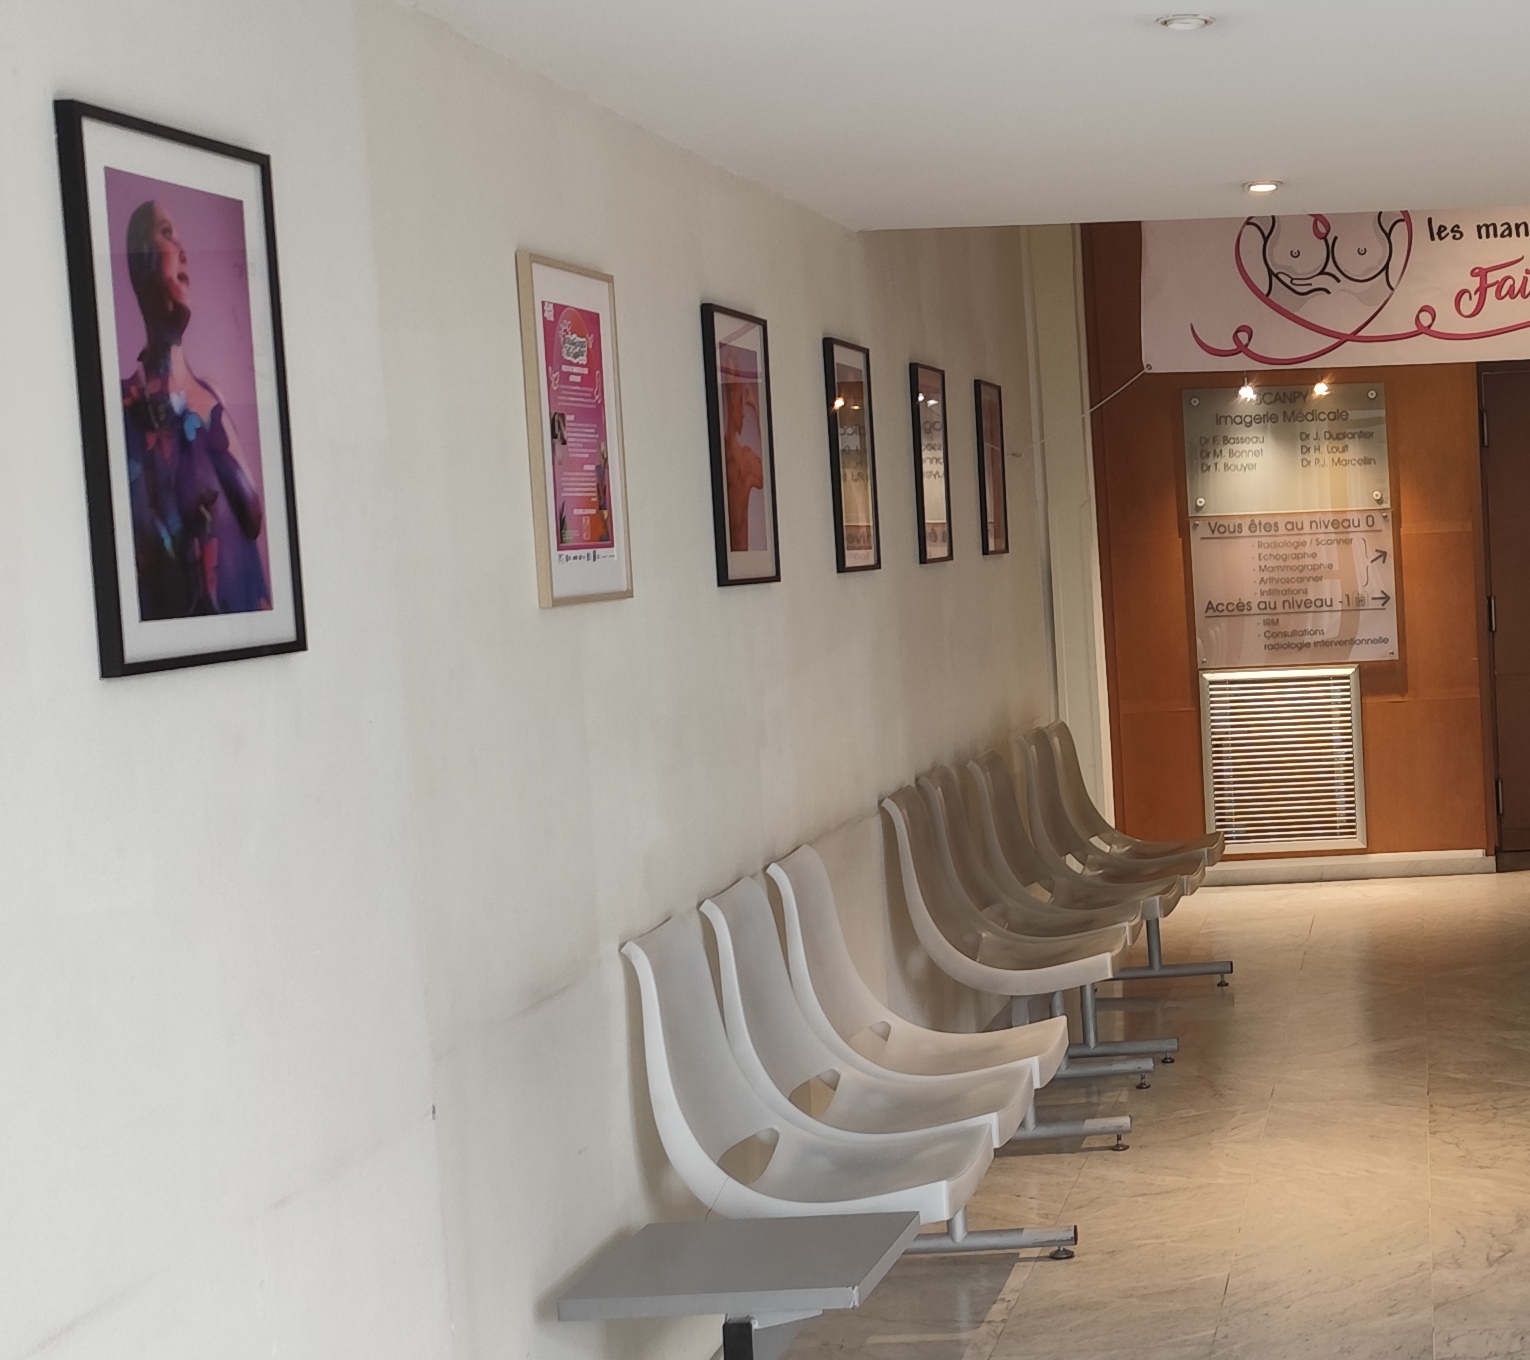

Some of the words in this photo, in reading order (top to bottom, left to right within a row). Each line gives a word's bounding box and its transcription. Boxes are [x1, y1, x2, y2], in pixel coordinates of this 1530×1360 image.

[1427, 216, 1465, 242] les
[1255, 390, 1309, 406] SCANPY
[1215, 410, 1279, 428] Imagerie
[1283, 408, 1350, 424] Médicale
[1199, 436, 1210, 446] Dr
[1299, 431, 1310, 442] Dr
[1200, 449, 1211, 460] Dr
[1229, 447, 1264, 459] Bonnet
[1300, 444, 1311, 455] Dr
[1201, 462, 1211, 473] Dr
[1301, 457, 1312, 468] Dr
[1208, 521, 1243, 535] Vous
[1248, 518, 1280, 534] êtes
[1284, 521, 1304, 532] au
[1309, 517, 1361, 531] niveau
[1365, 514, 1375, 528] 0
[1257, 539, 1307, 551] Radiologie
[1316, 536, 1354, 546] Scanner
[1258, 551, 1318, 563] Echographie
[1258, 562, 1334, 574] Mammographie
[1258, 574, 1324, 586] Arthroscanner
[1204, 597, 1253, 614] Accès
[1257, 600, 1277, 611] au
[1282, 596, 1334, 610] niveau
[1262, 618, 1280, 627] IRM
[1263, 627, 1326, 639] Consultations
[1263, 640, 1311, 651] radiologie
[1313, 636, 1390, 649] interventionnelle
